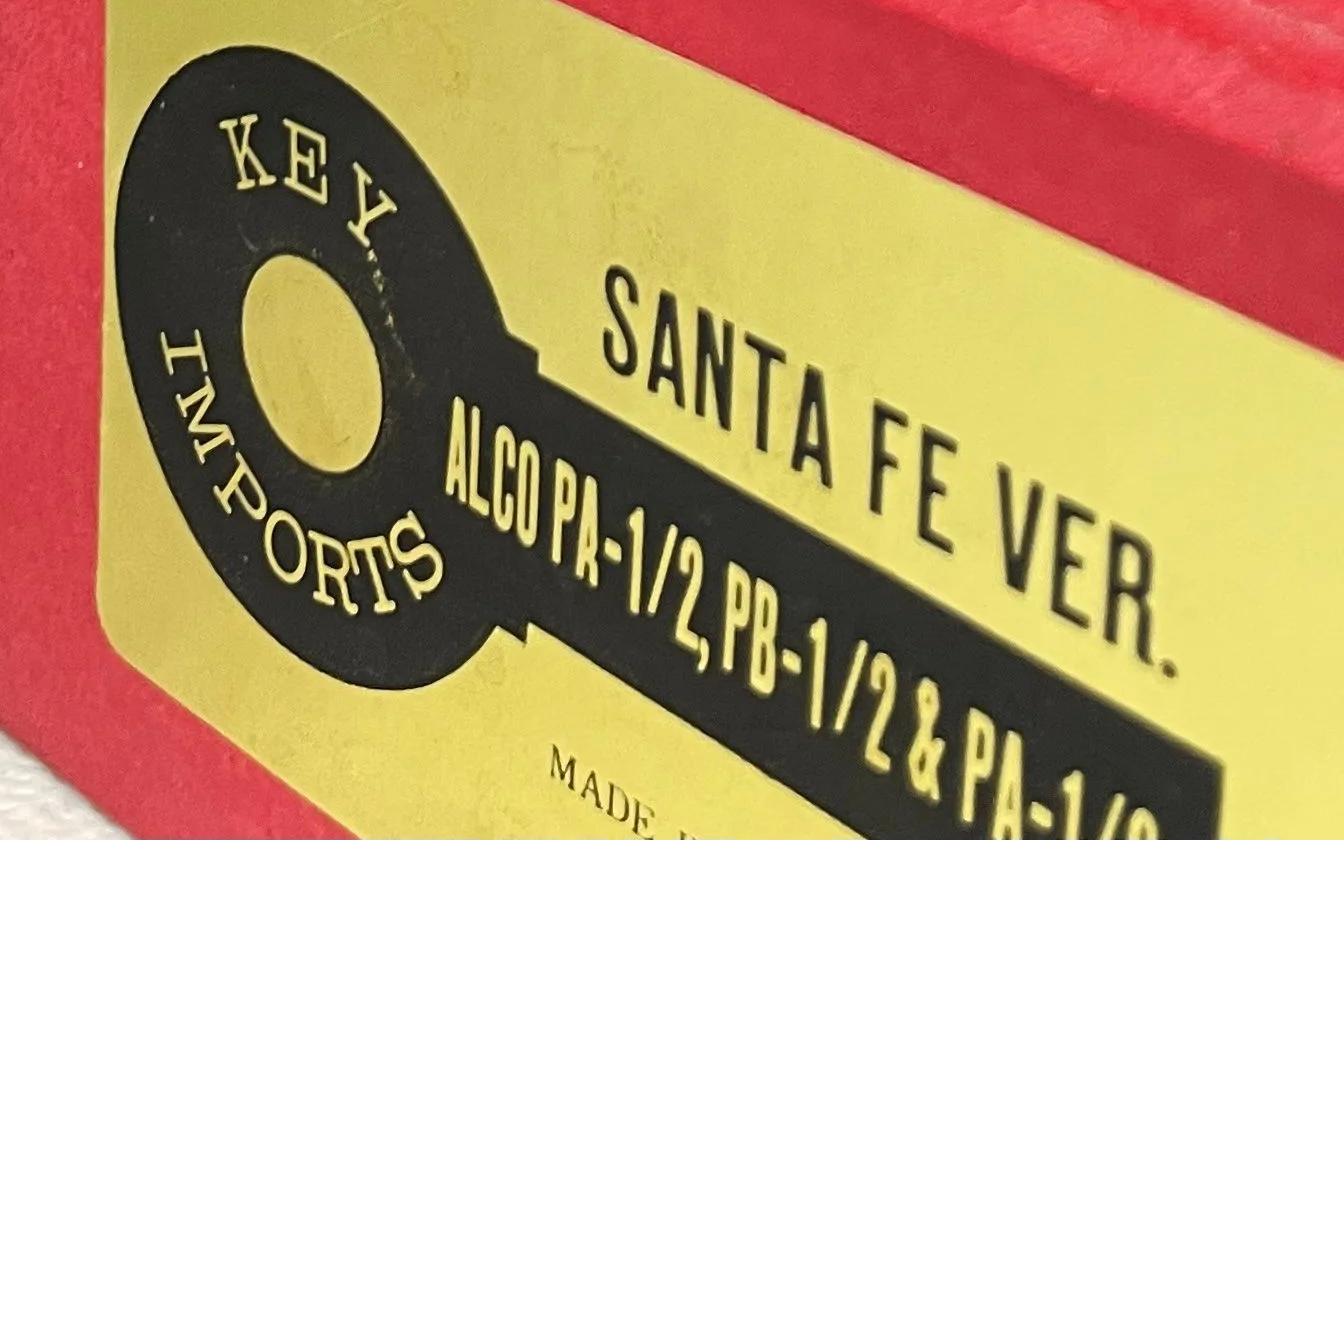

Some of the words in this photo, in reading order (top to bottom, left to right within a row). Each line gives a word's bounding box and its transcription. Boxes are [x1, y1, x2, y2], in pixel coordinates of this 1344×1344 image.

[219, 113, 397, 246] KEY
[159, 329, 444, 616] IMPORTS
[444, 395, 540, 548] ALCO
[551, 457, 712, 676] PA-1/2,
[721, 560, 898, 774] PB-1/2
[908, 676, 946, 804] &
[602, 264, 834, 490] SANTA
[868, 398, 959, 556] FE
[997, 462, 1179, 679] VER.
[549, 743, 656, 840] MADE
